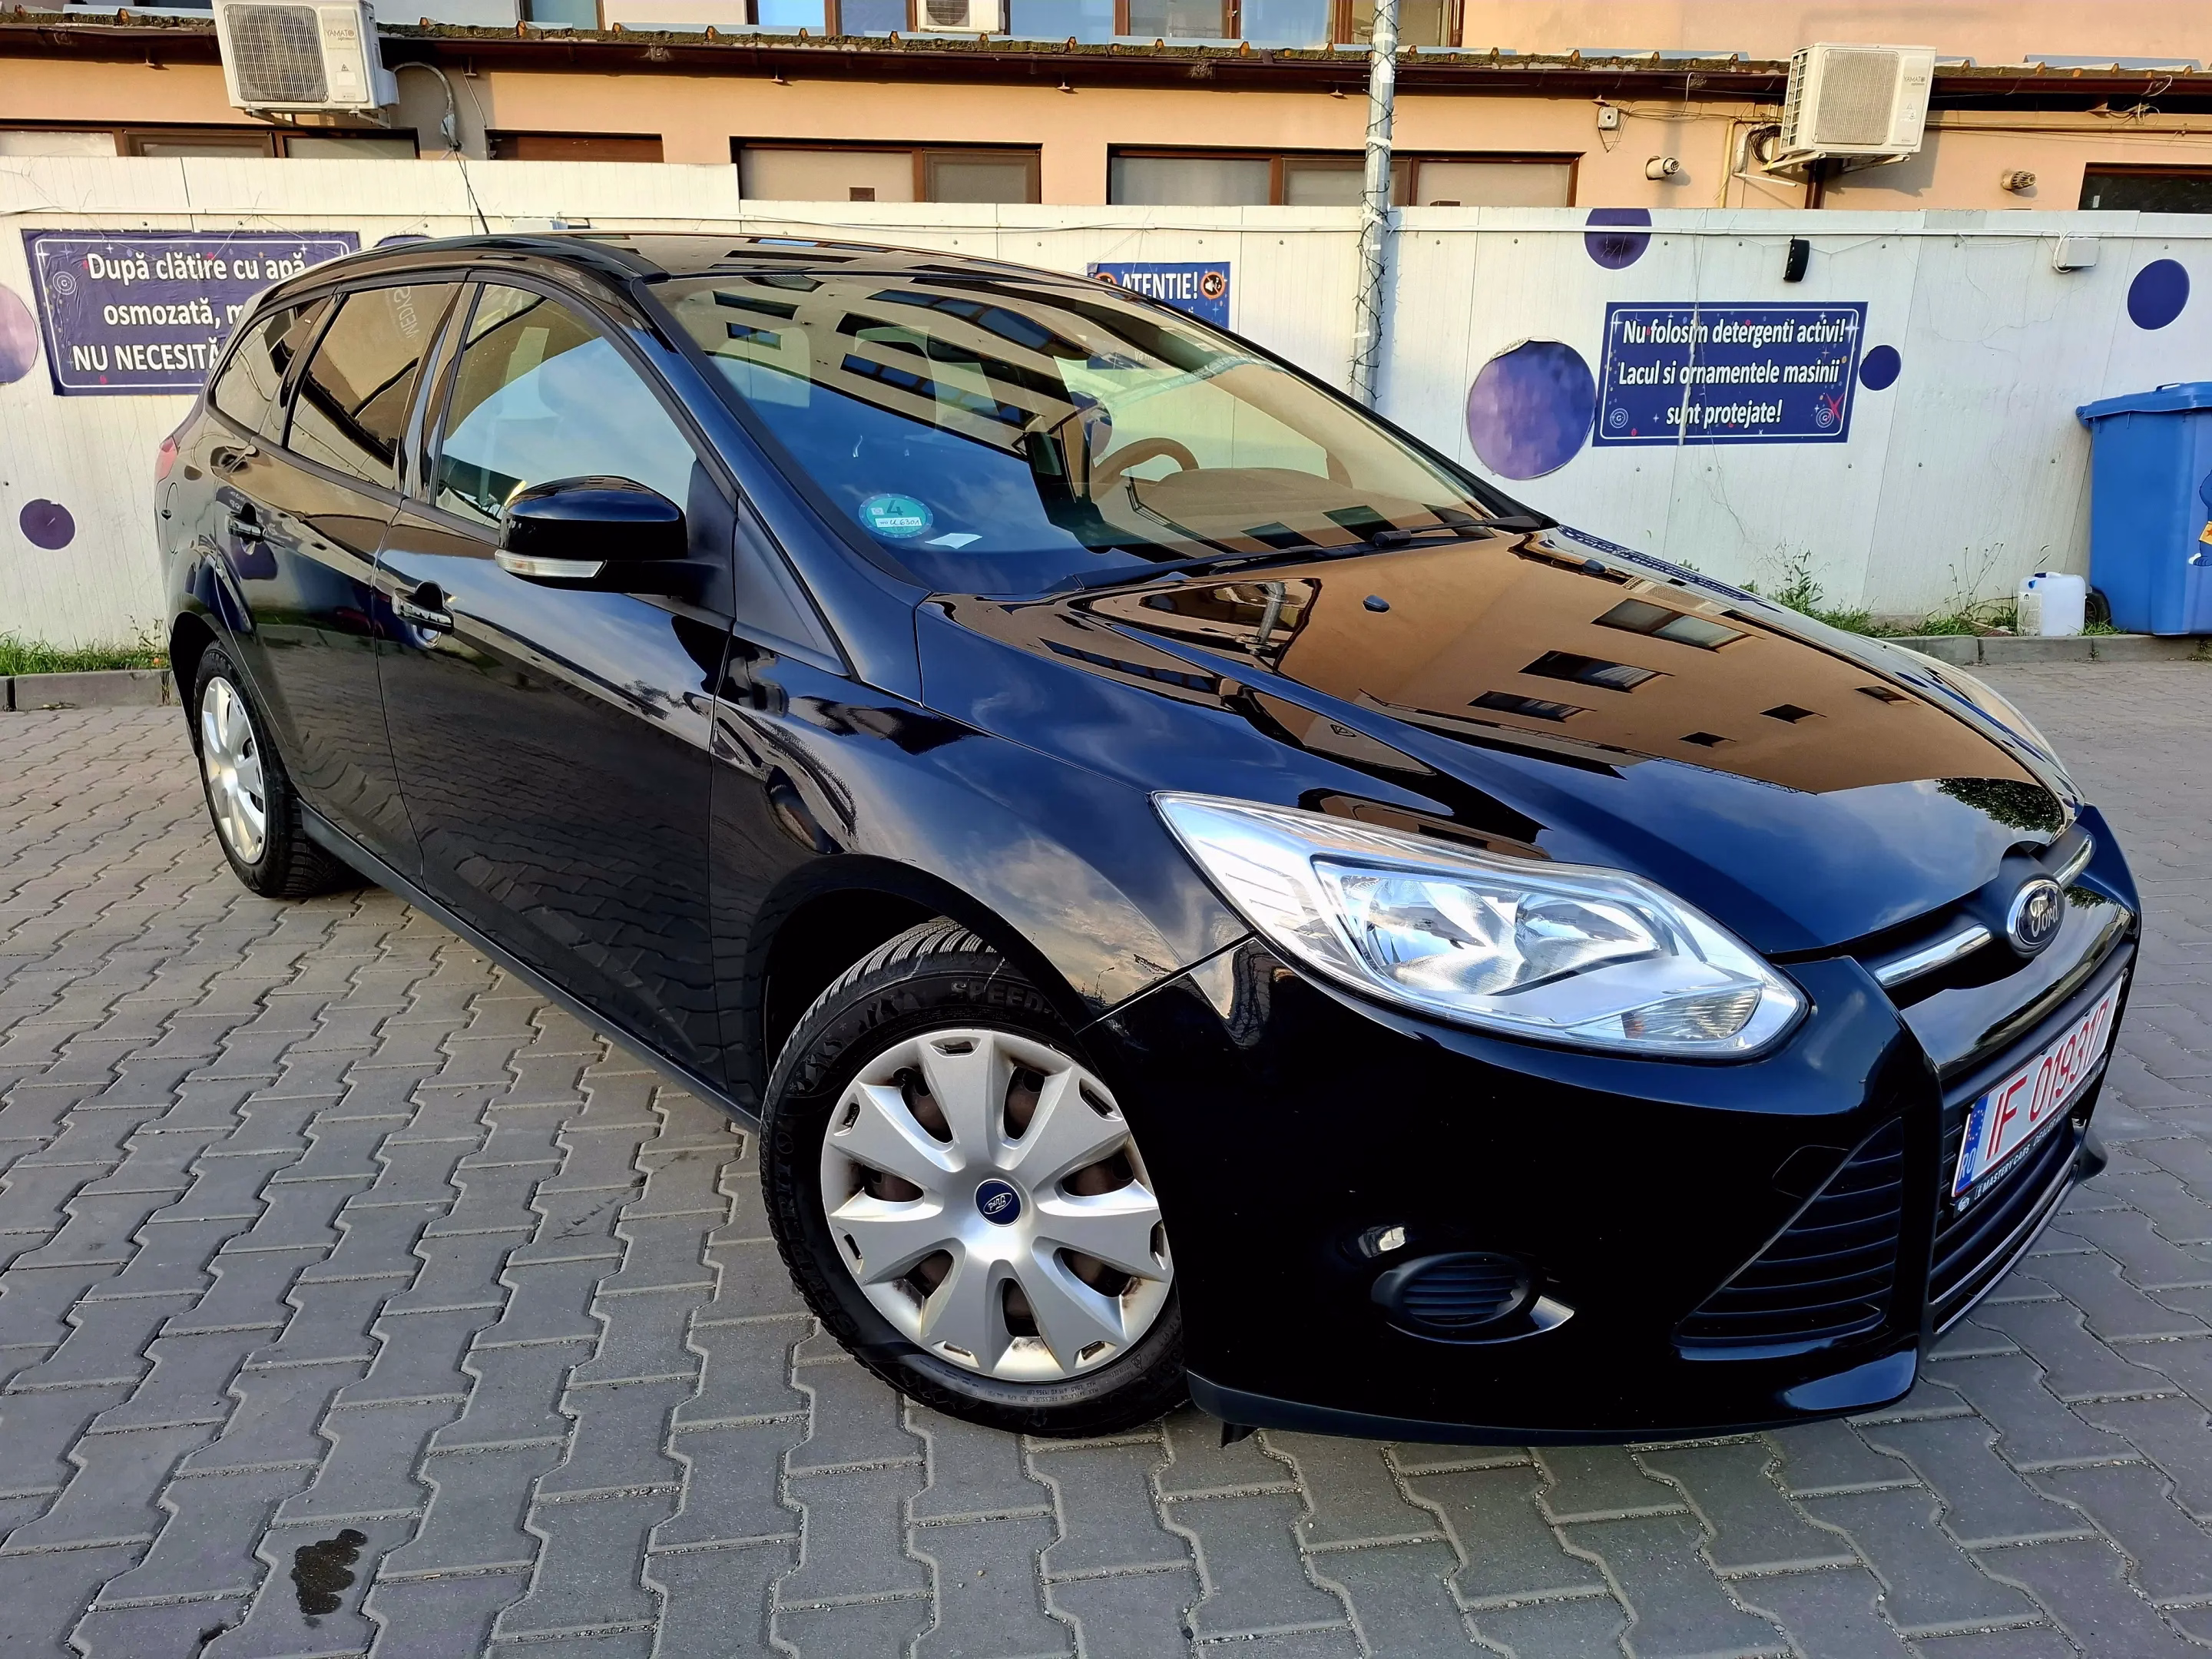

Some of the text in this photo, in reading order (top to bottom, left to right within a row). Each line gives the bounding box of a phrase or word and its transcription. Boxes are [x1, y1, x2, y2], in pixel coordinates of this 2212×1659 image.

[88, 253, 150, 286] După
[156, 253, 227, 281] clătire
[233, 260, 260, 280] cu
[103, 297, 221, 330] osmozată,
[1623, 317, 1845, 349] Nu folosim detergenti activi!
[72, 336, 220, 373] NU NECESITĂ
[1618, 359, 1840, 385] Lacul si ornamentele masinii
[1666, 401, 1700, 425] sunt
[1704, 399, 1783, 430] protejate!
[887, 499, 904, 516] 4
[2031, 892, 2060, 938] Ford
[1985, 1075, 2028, 1161] IF
[2028, 995, 2110, 1124] 019317
[1959, 1147, 1976, 1181] RO
